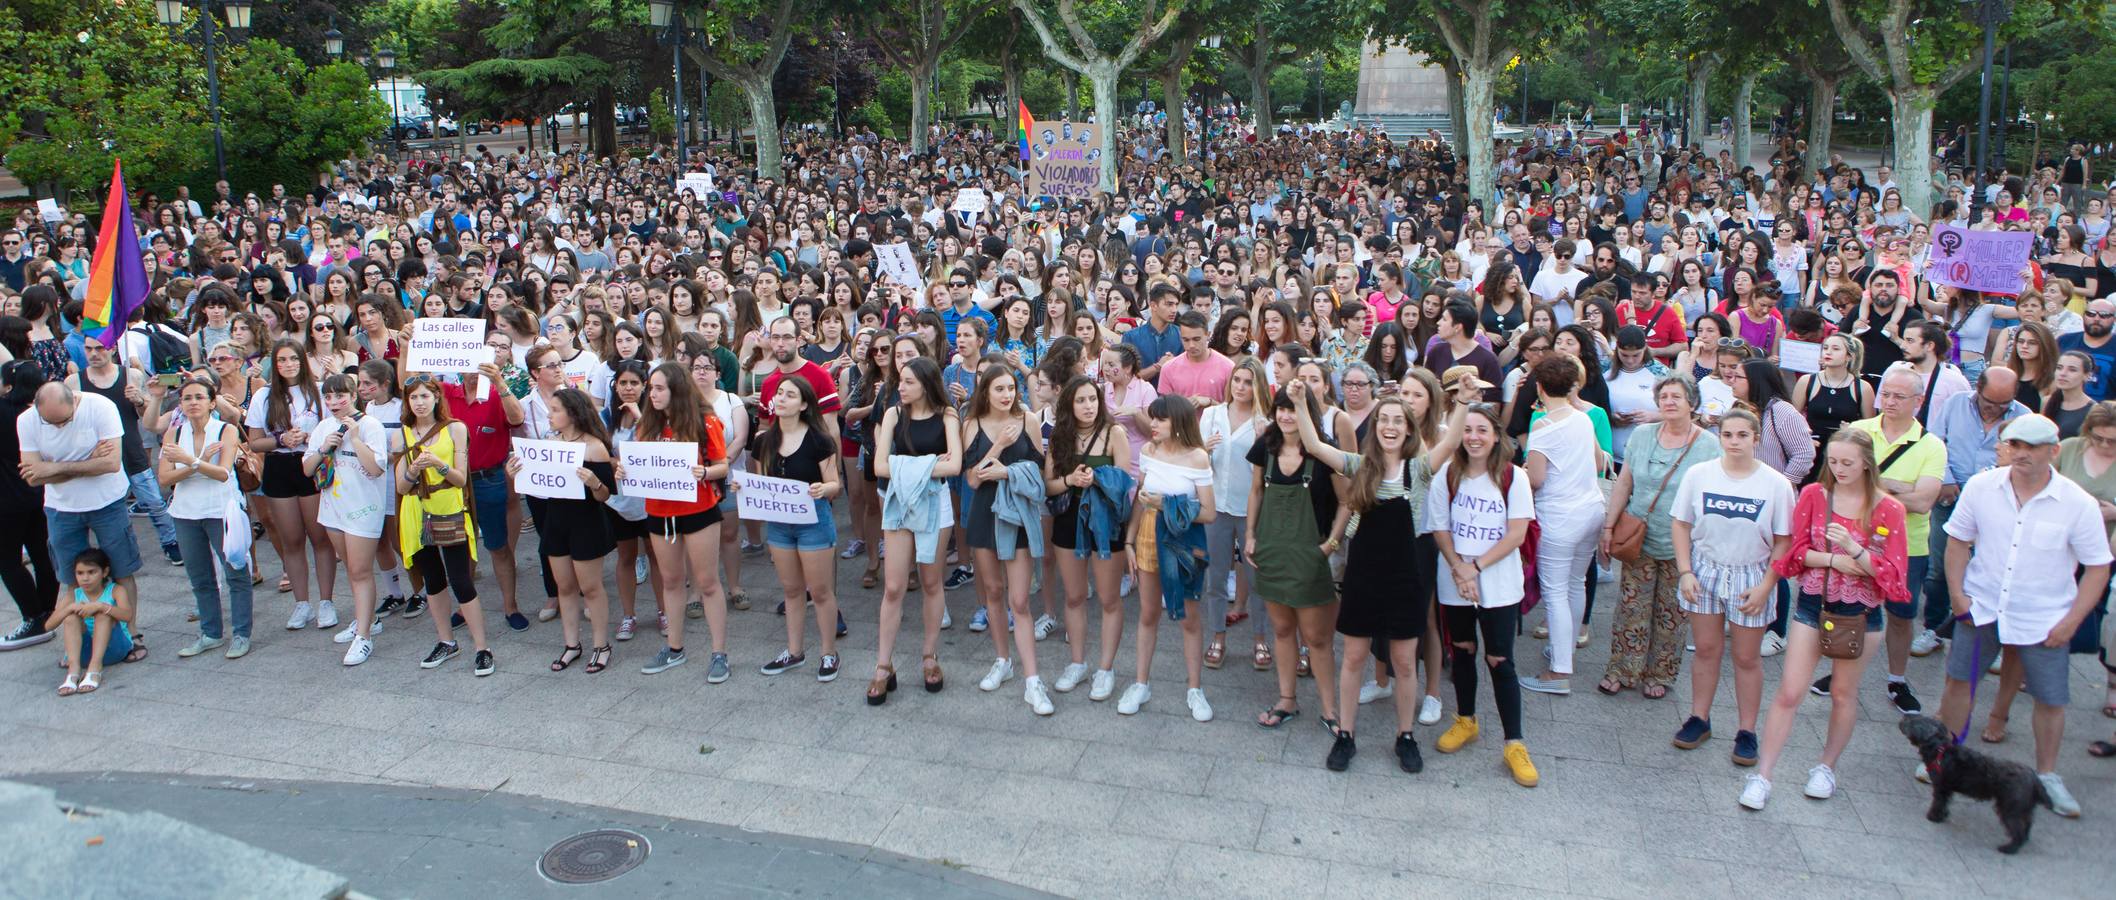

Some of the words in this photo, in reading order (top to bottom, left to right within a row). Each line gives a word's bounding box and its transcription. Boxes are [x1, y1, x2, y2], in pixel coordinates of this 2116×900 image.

[1035, 163, 1100, 188] VIOLADORES
[1040, 182, 1090, 197] SUELTOS
[1964, 239, 2026, 264] MUJER
[422, 322, 440, 332] Las
[442, 322, 475, 333] calles
[412, 339, 459, 350] también
[461, 342, 483, 350] son
[421, 358, 471, 367] nuestras
[520, 446, 537, 460] YO
[540, 449, 553, 462] SI
[557, 451, 576, 464] TE
[627, 455, 648, 467] Ser
[650, 455, 690, 470] libres,
[530, 472, 566, 488] CREO
[622, 478, 638, 492] no
[639, 478, 695, 491] valientes
[745, 478, 801, 495] JUNTAS
[769, 492, 777, 501] Y
[745, 496, 809, 514] FUERTES
